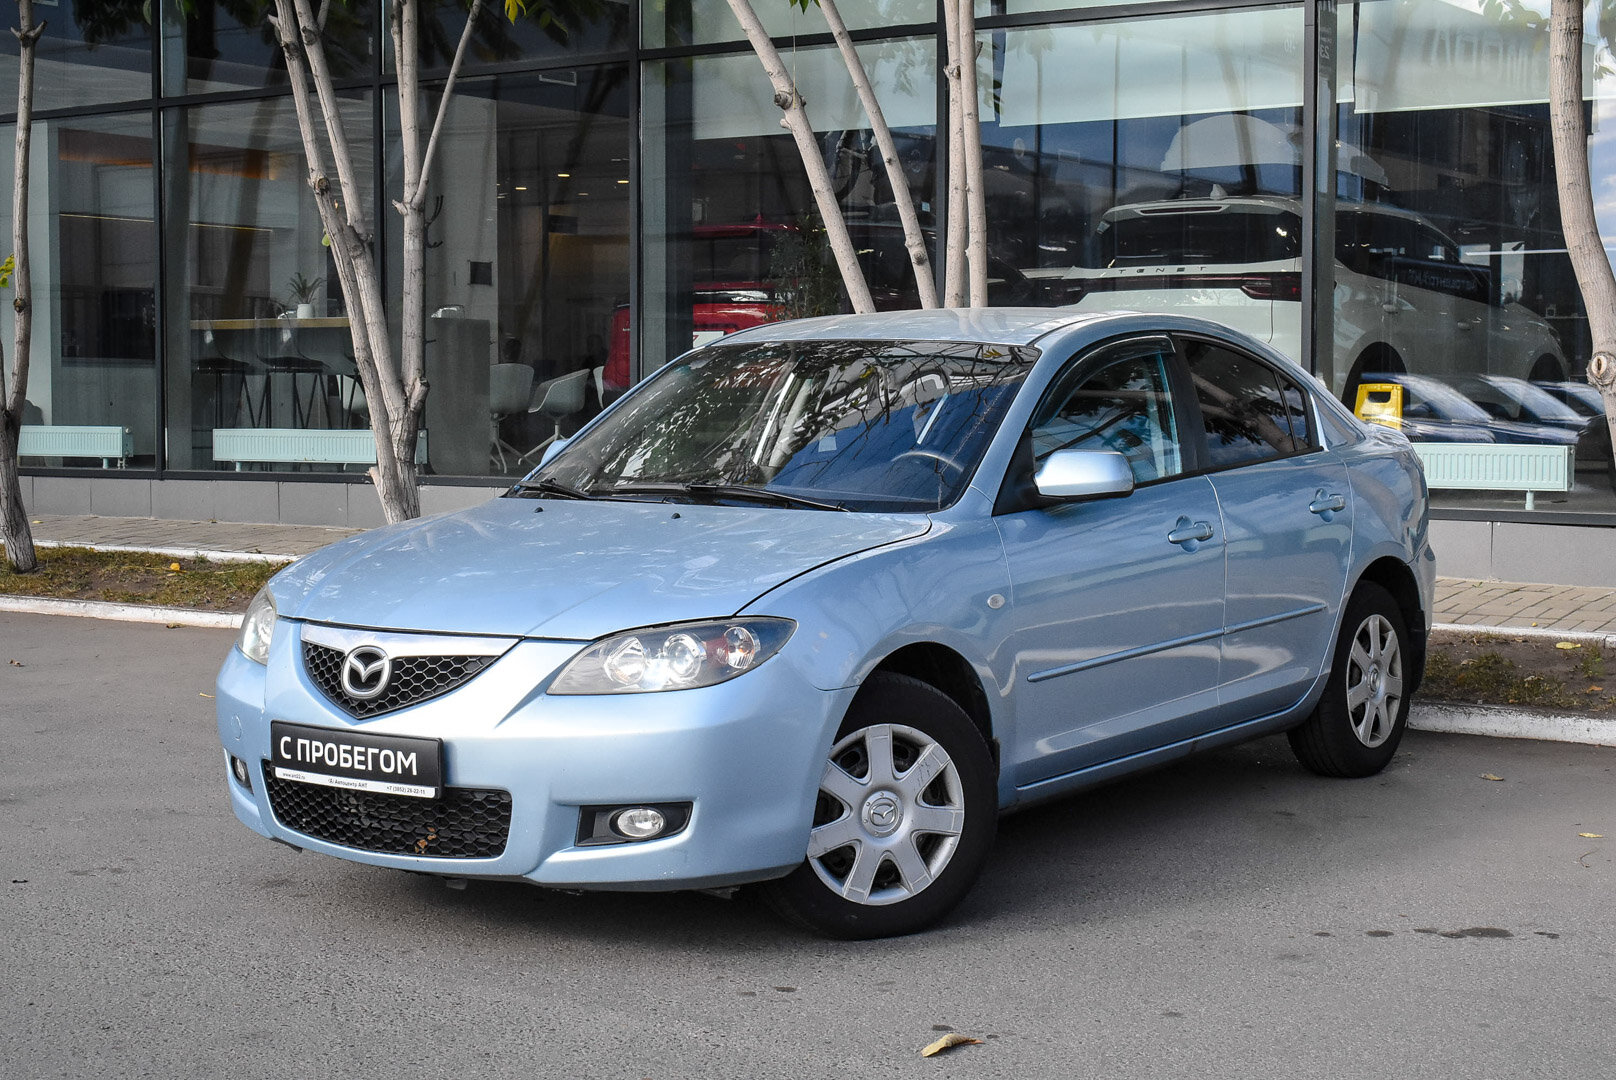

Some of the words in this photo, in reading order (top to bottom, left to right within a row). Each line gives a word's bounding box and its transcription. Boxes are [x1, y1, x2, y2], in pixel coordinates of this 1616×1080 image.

[1119, 266, 1206, 274] TENET
[280, 736, 291, 759] С
[297, 738, 417, 775] ПРОБЕГОМ
